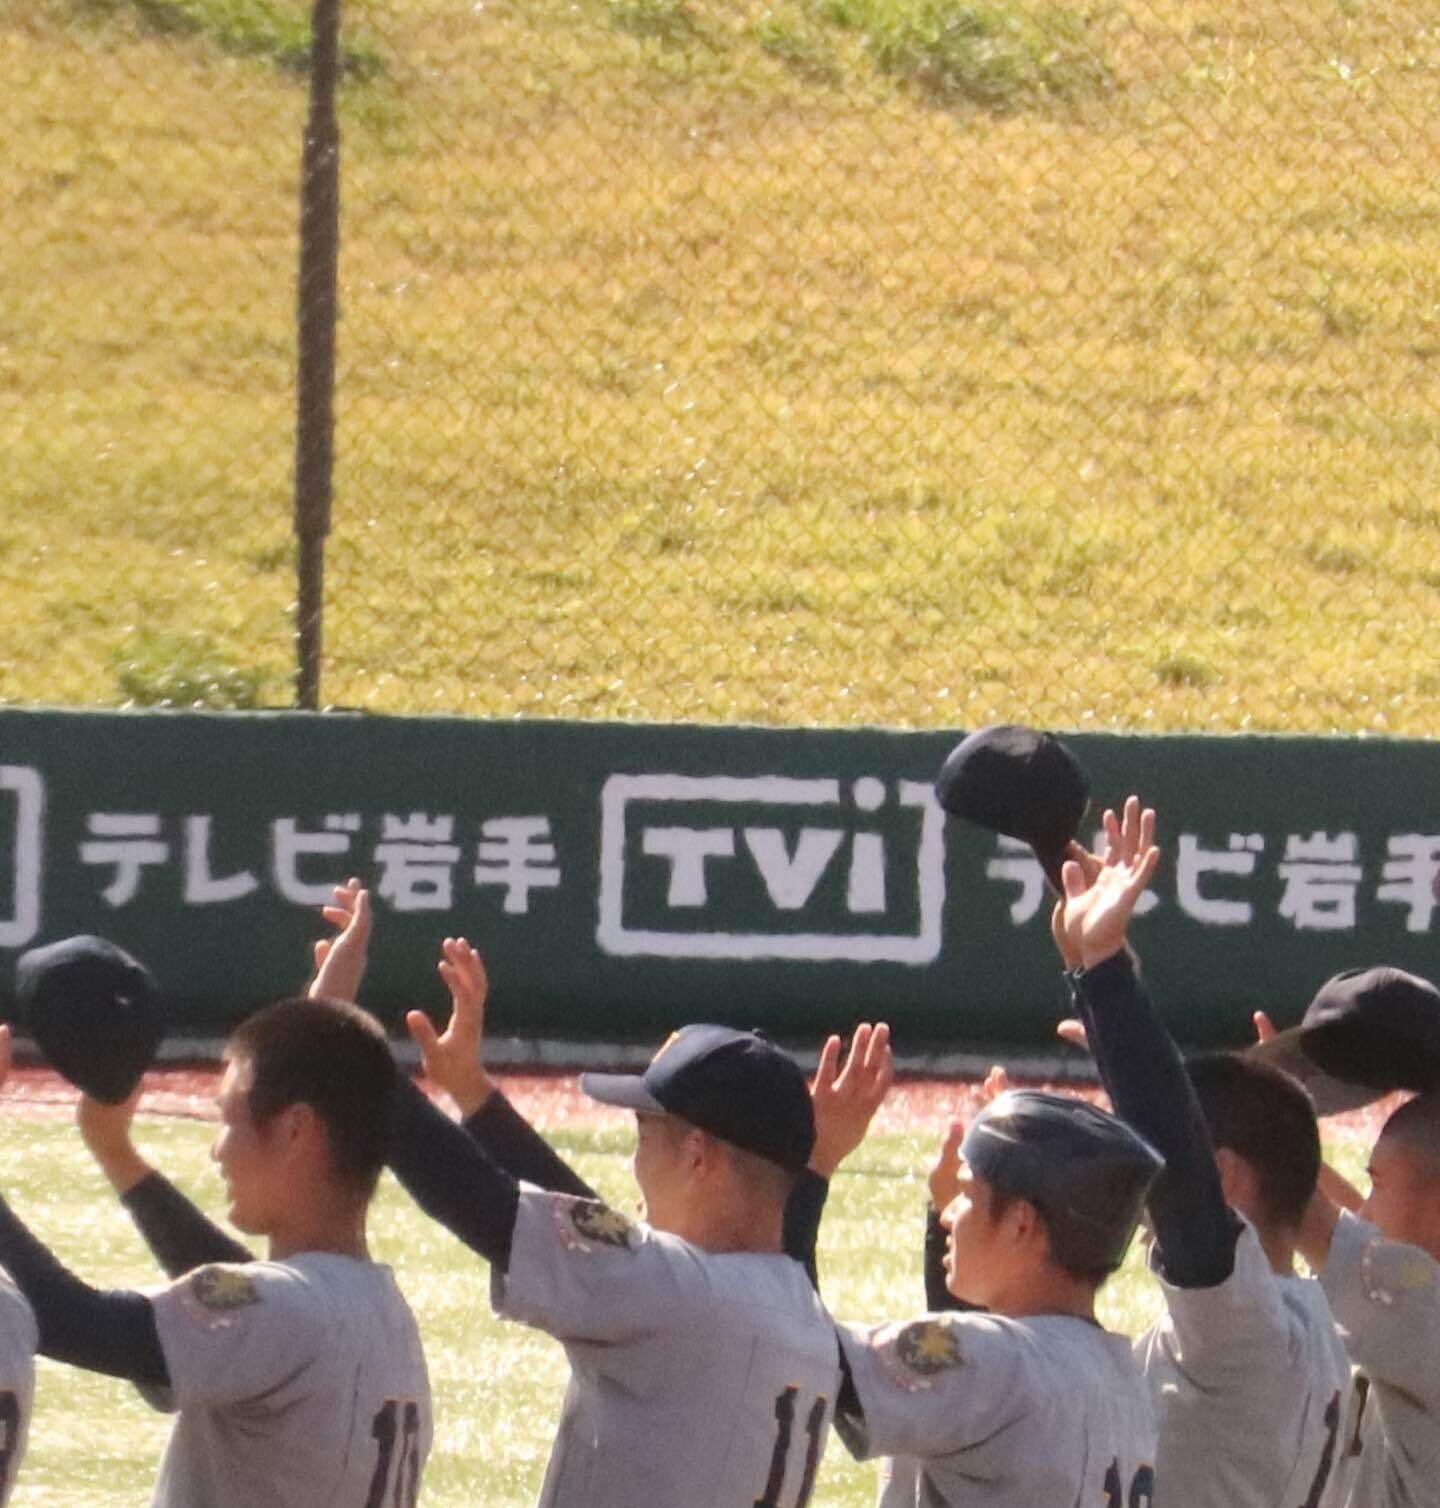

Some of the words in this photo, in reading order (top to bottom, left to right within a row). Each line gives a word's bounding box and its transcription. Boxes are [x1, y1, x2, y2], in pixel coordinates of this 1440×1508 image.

[77, 811, 561, 914] テレビ岩手
